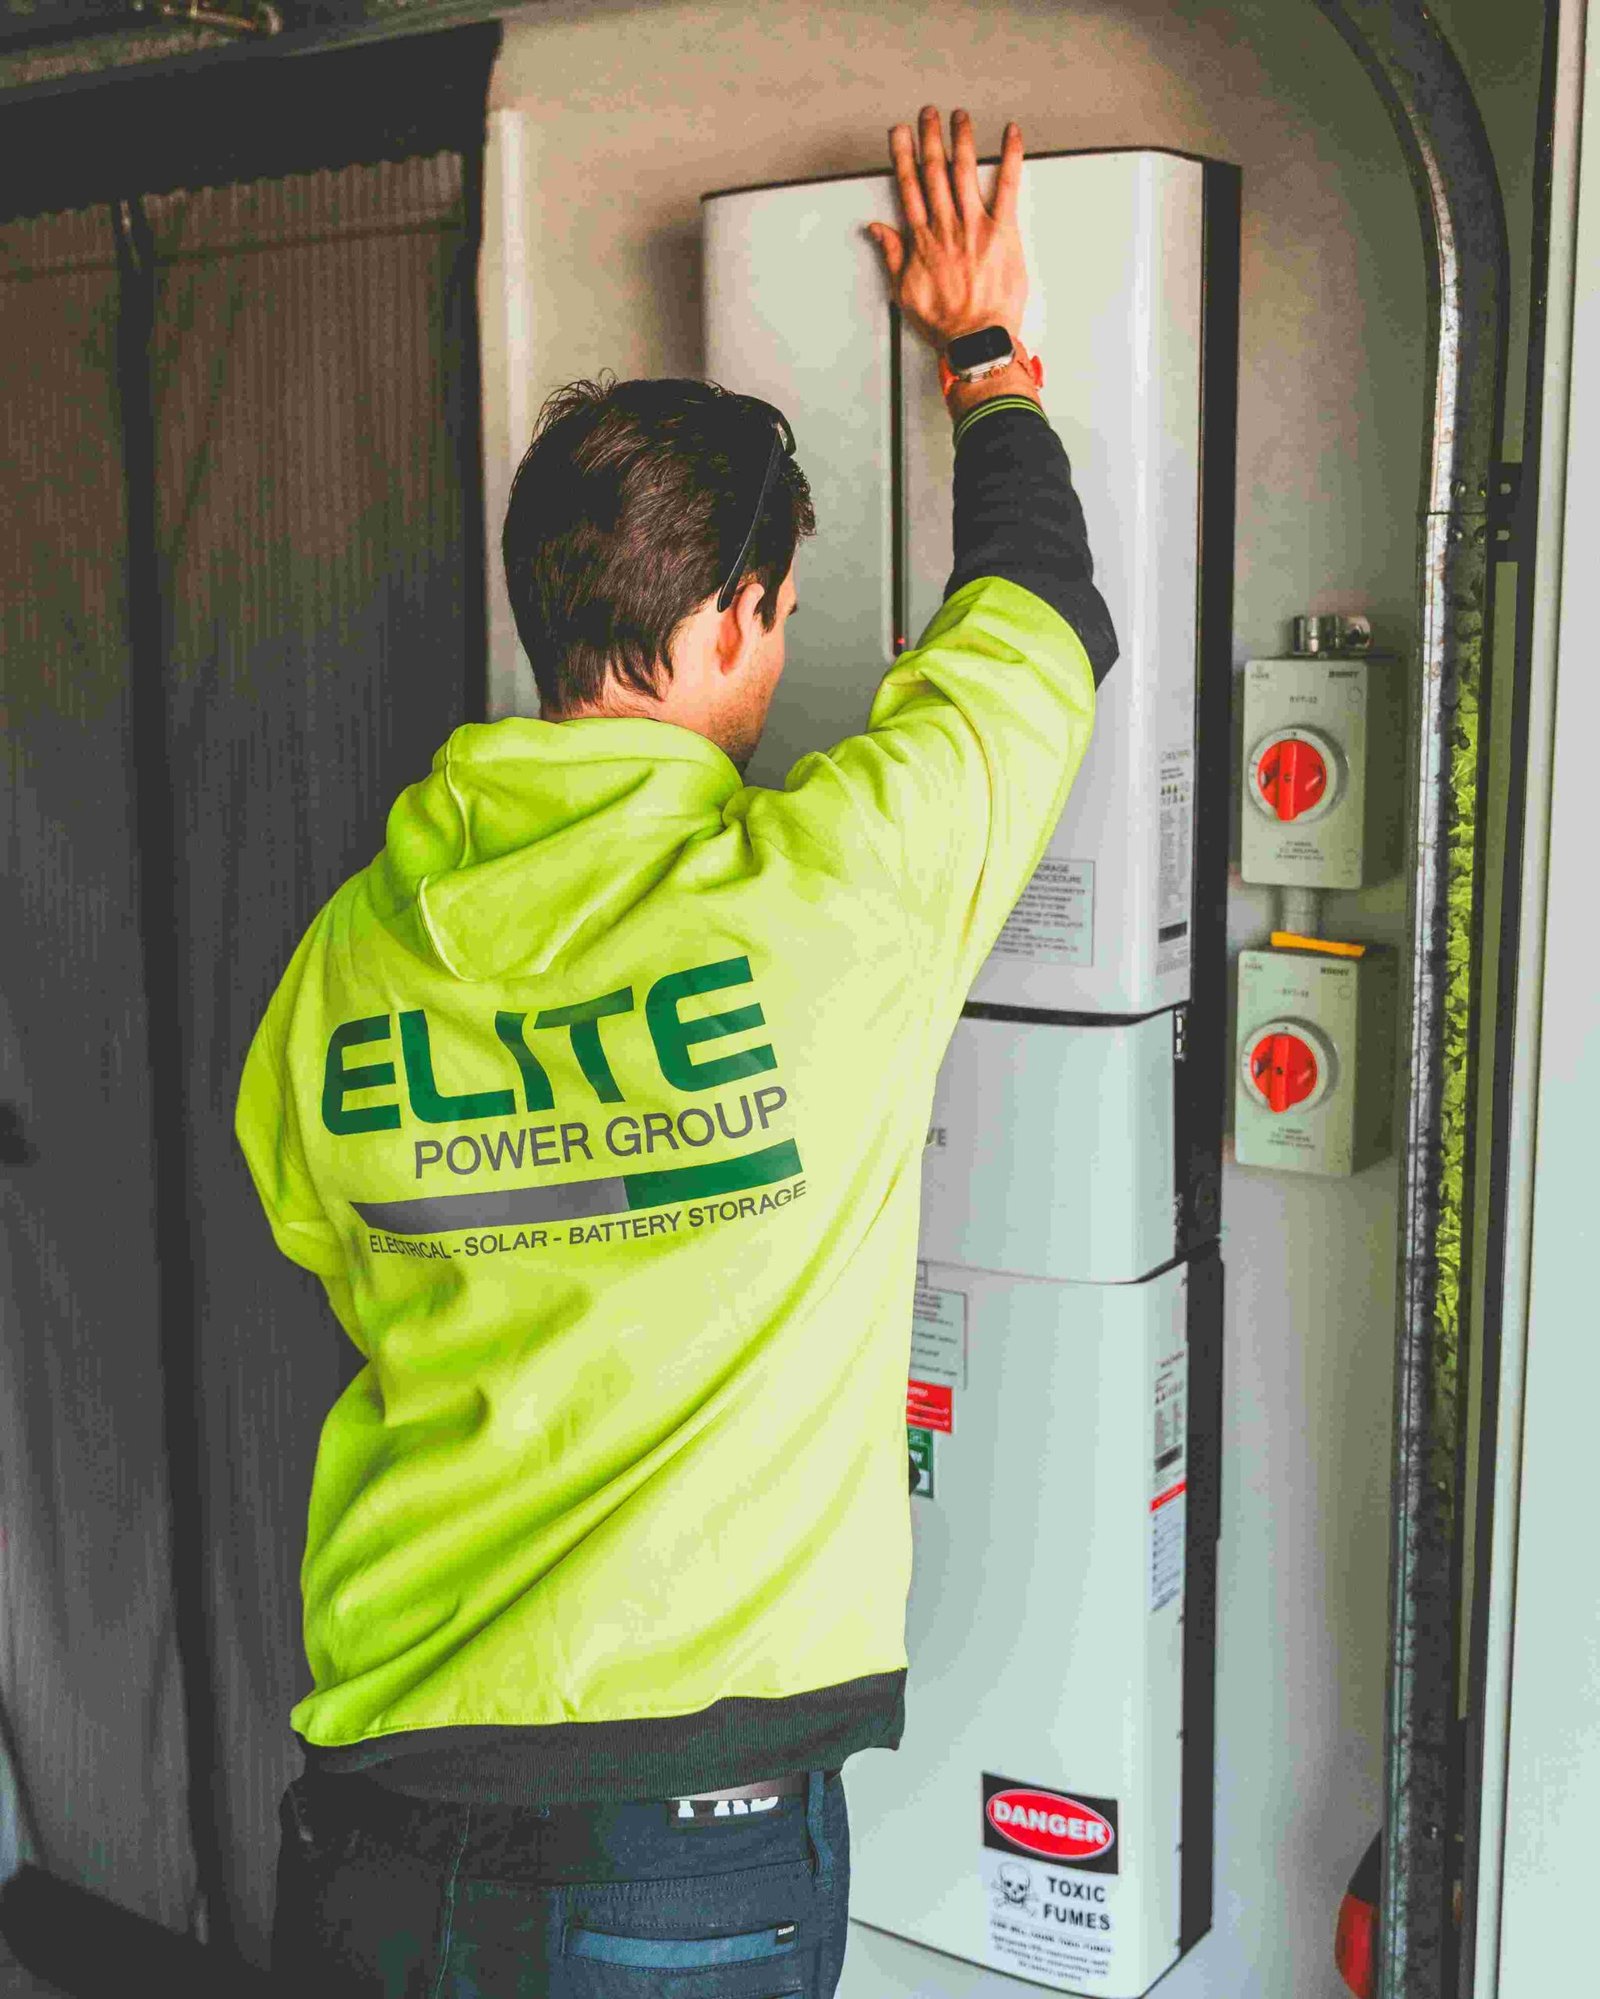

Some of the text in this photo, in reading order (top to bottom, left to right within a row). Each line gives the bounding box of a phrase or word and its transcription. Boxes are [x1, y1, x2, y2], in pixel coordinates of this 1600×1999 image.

[322, 956, 778, 1136] ELITE
[414, 1086, 789, 1179] POWER GROUP
[369, 1234, 452, 1260] ELECTRICAL
[465, 1230, 547, 1254] SOLAR
[569, 1211, 681, 1245] BATTERY
[688, 1180, 807, 1227] STORAGE
[993, 1800, 1107, 1844] DANGER
[1044, 1904, 1110, 1930] FUMES
[1048, 1877, 1105, 1903] TOXIC
